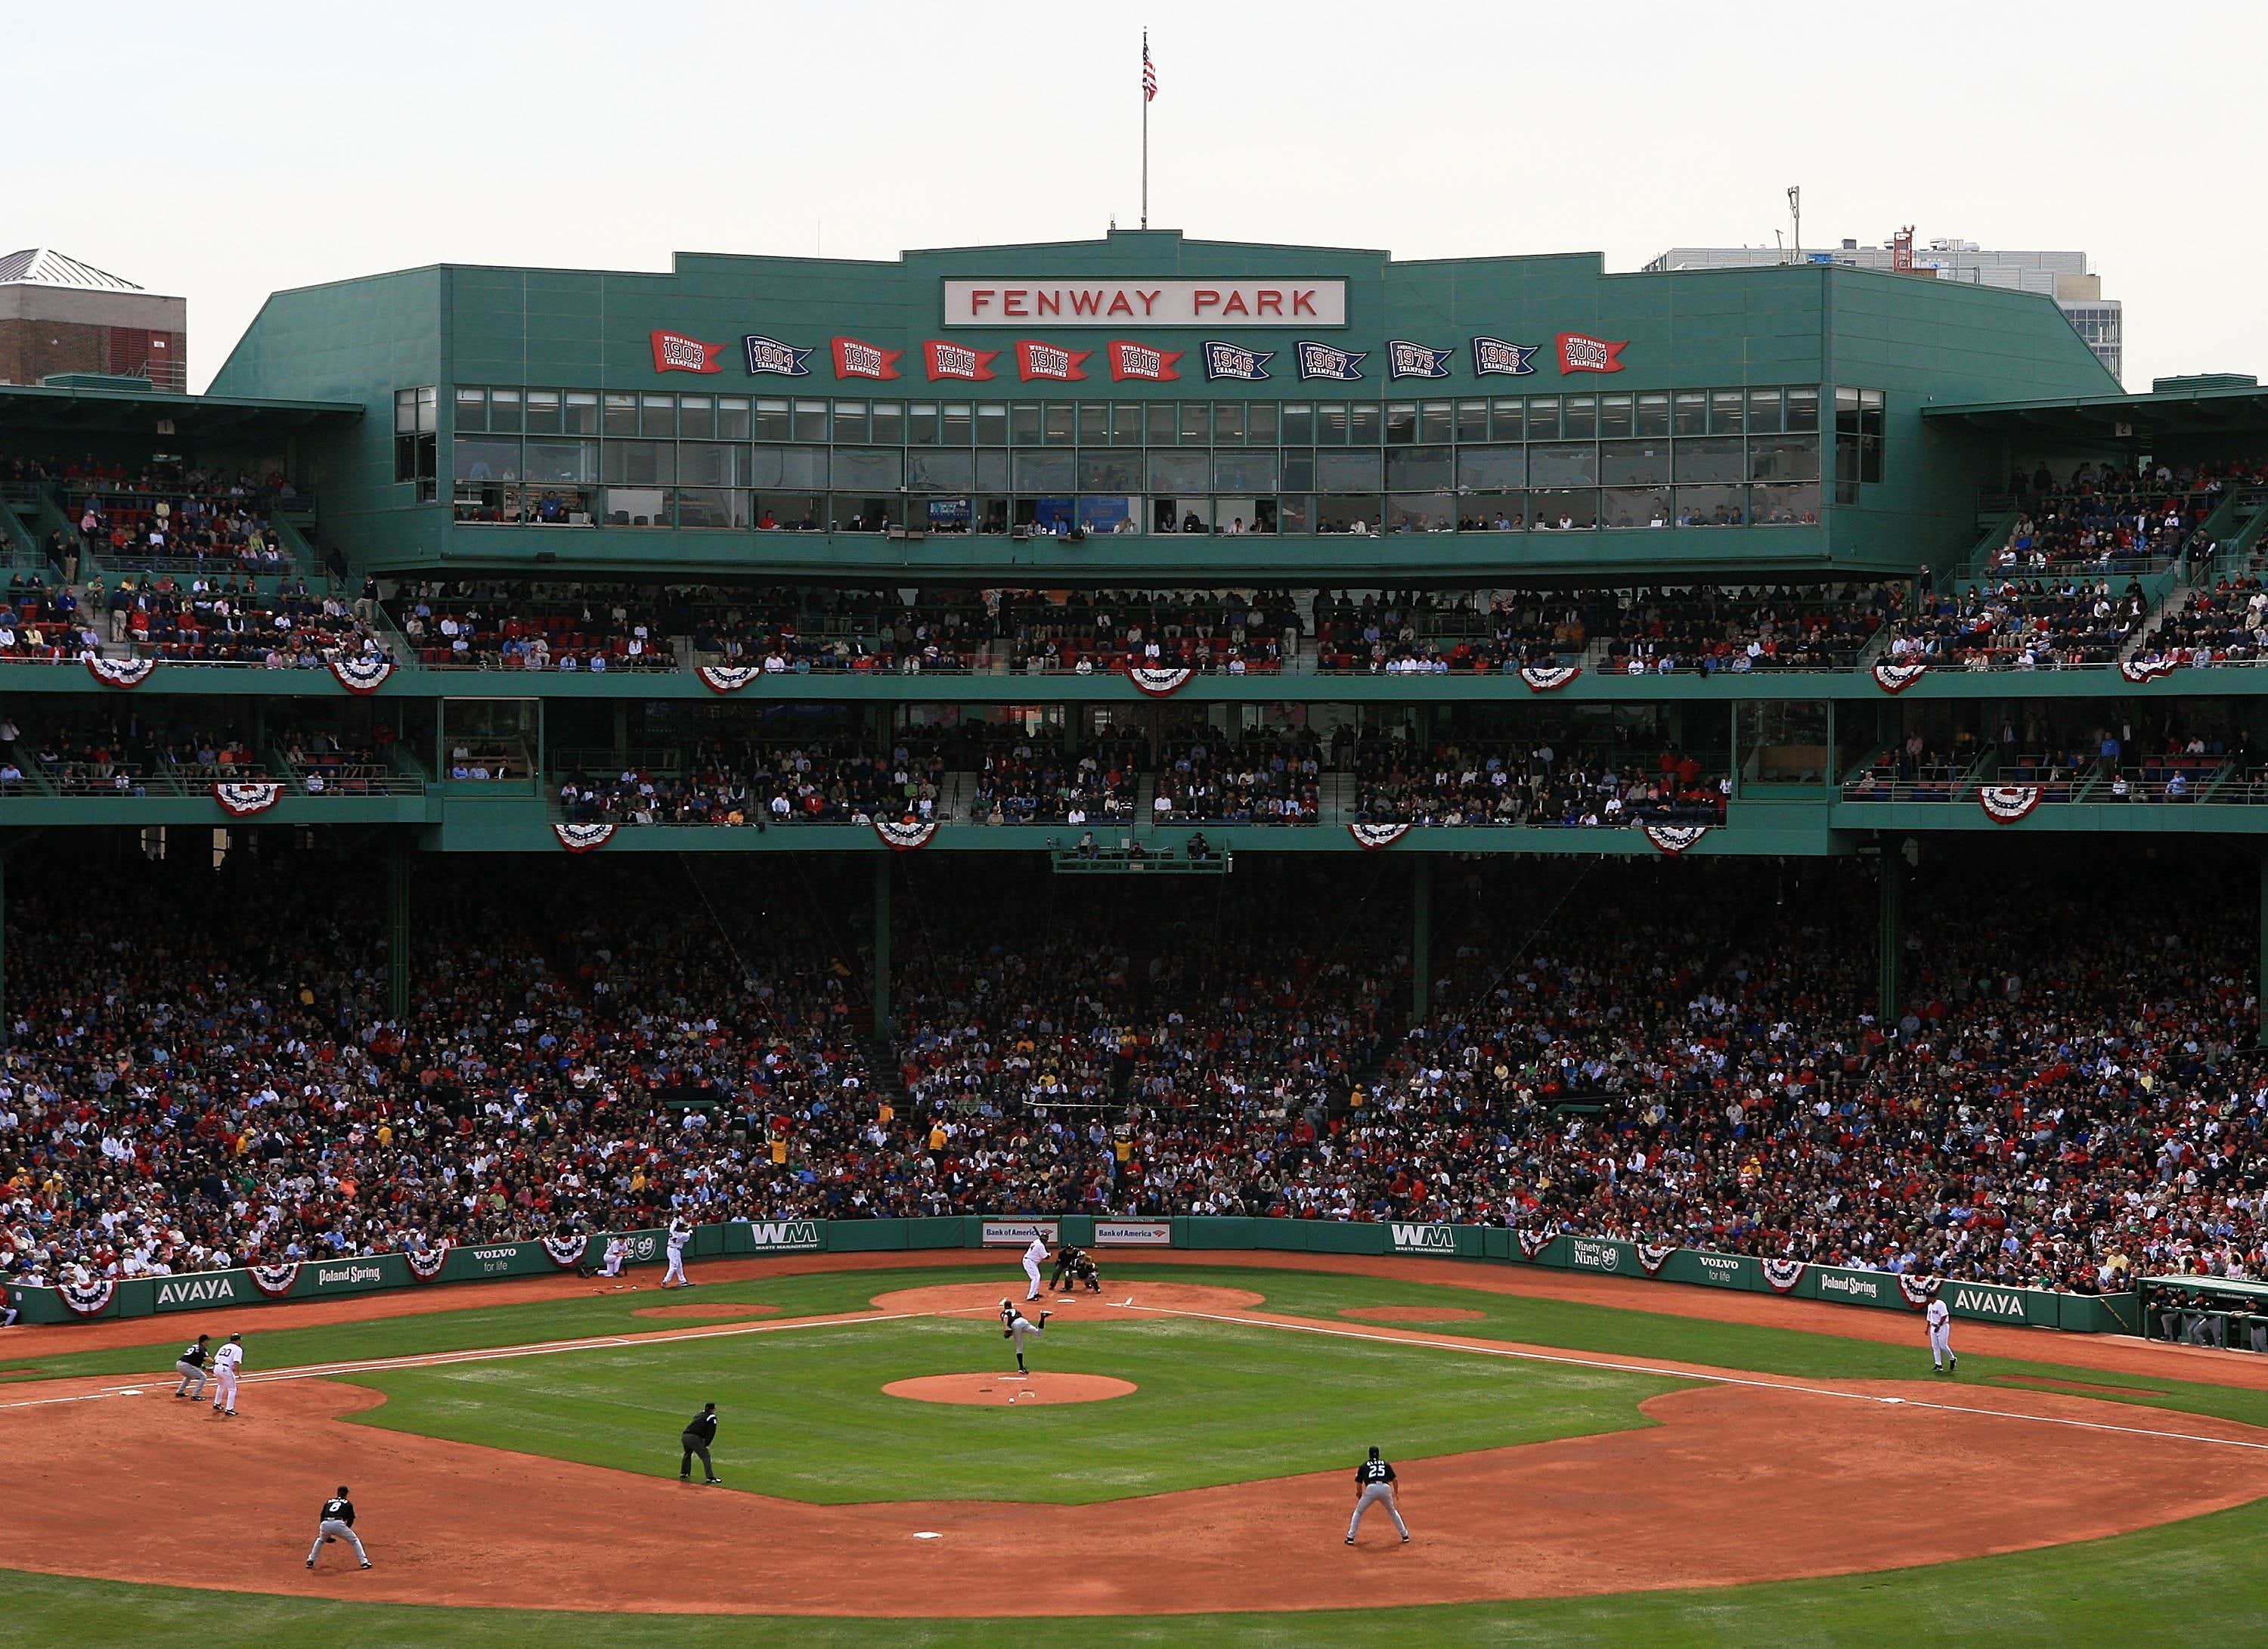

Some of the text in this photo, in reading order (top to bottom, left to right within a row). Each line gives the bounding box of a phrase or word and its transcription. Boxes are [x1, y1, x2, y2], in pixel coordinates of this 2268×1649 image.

[972, 290, 1317, 316] FENWAY PARK
[664, 336, 702, 349] WORLD SERIES
[1588, 339, 1606, 349] SERIES
[664, 342, 704, 364] 1903
[754, 346, 793, 367] 1904
[844, 343, 881, 357] WORLD SERIES
[957, 346, 975, 357] SERIES
[1050, 348, 1068, 358] SERIES
[1141, 348, 1160, 358] SERIES
[1481, 346, 1519, 367] 1986
[1566, 343, 1607, 364] 2004
[667, 358, 701, 370] CHAMPIONS
[845, 349, 880, 370] 1912
[937, 349, 974, 371] 1915
[1030, 351, 1067, 370] 1916
[1122, 351, 1160, 371] 1918
[1213, 352, 1253, 371] 1946
[1306, 352, 1346, 371] 1967
[1397, 350, 1434, 370] 1975
[1570, 359, 1604, 369] CHAMPIONS
[758, 362, 792, 373] CHAMPIONS
[847, 364, 879, 377] CHAMPIONS
[938, 366, 974, 377] CHAMPIONS
[1031, 366, 1066, 377] CHAMPIONS
[1123, 366, 1158, 377] CHAMPIONS
[1216, 367, 1250, 377] CHAMPIONS
[1309, 367, 1344, 377] CHAMPIONS
[1399, 366, 1431, 375] CHAMPIONS
[1484, 362, 1517, 372] CHAMPIONS
[751, 1222, 817, 1244] WM
[1391, 1224, 1454, 1247] WM
[638, 1237, 652, 1254] 99
[1574, 1240, 1600, 1255] Ninety
[473, 1248, 516, 1260] VOLVO
[1574, 1251, 1599, 1265] Nine
[1603, 1248, 1616, 1263] 99
[484, 1260, 508, 1272] for life
[1699, 1257, 1739, 1269] VOLVO
[319, 1266, 380, 1285] Poland Spring
[1709, 1269, 1730, 1282] for life
[158, 1279, 234, 1303] AVAYA
[1822, 1274, 1876, 1298] Poland Spring
[1954, 1289, 2024, 1316] AVAYA
[218, 1348, 231, 1356] 20
[1368, 1465, 1385, 1478] 25
[330, 1502, 342, 1511] 8
